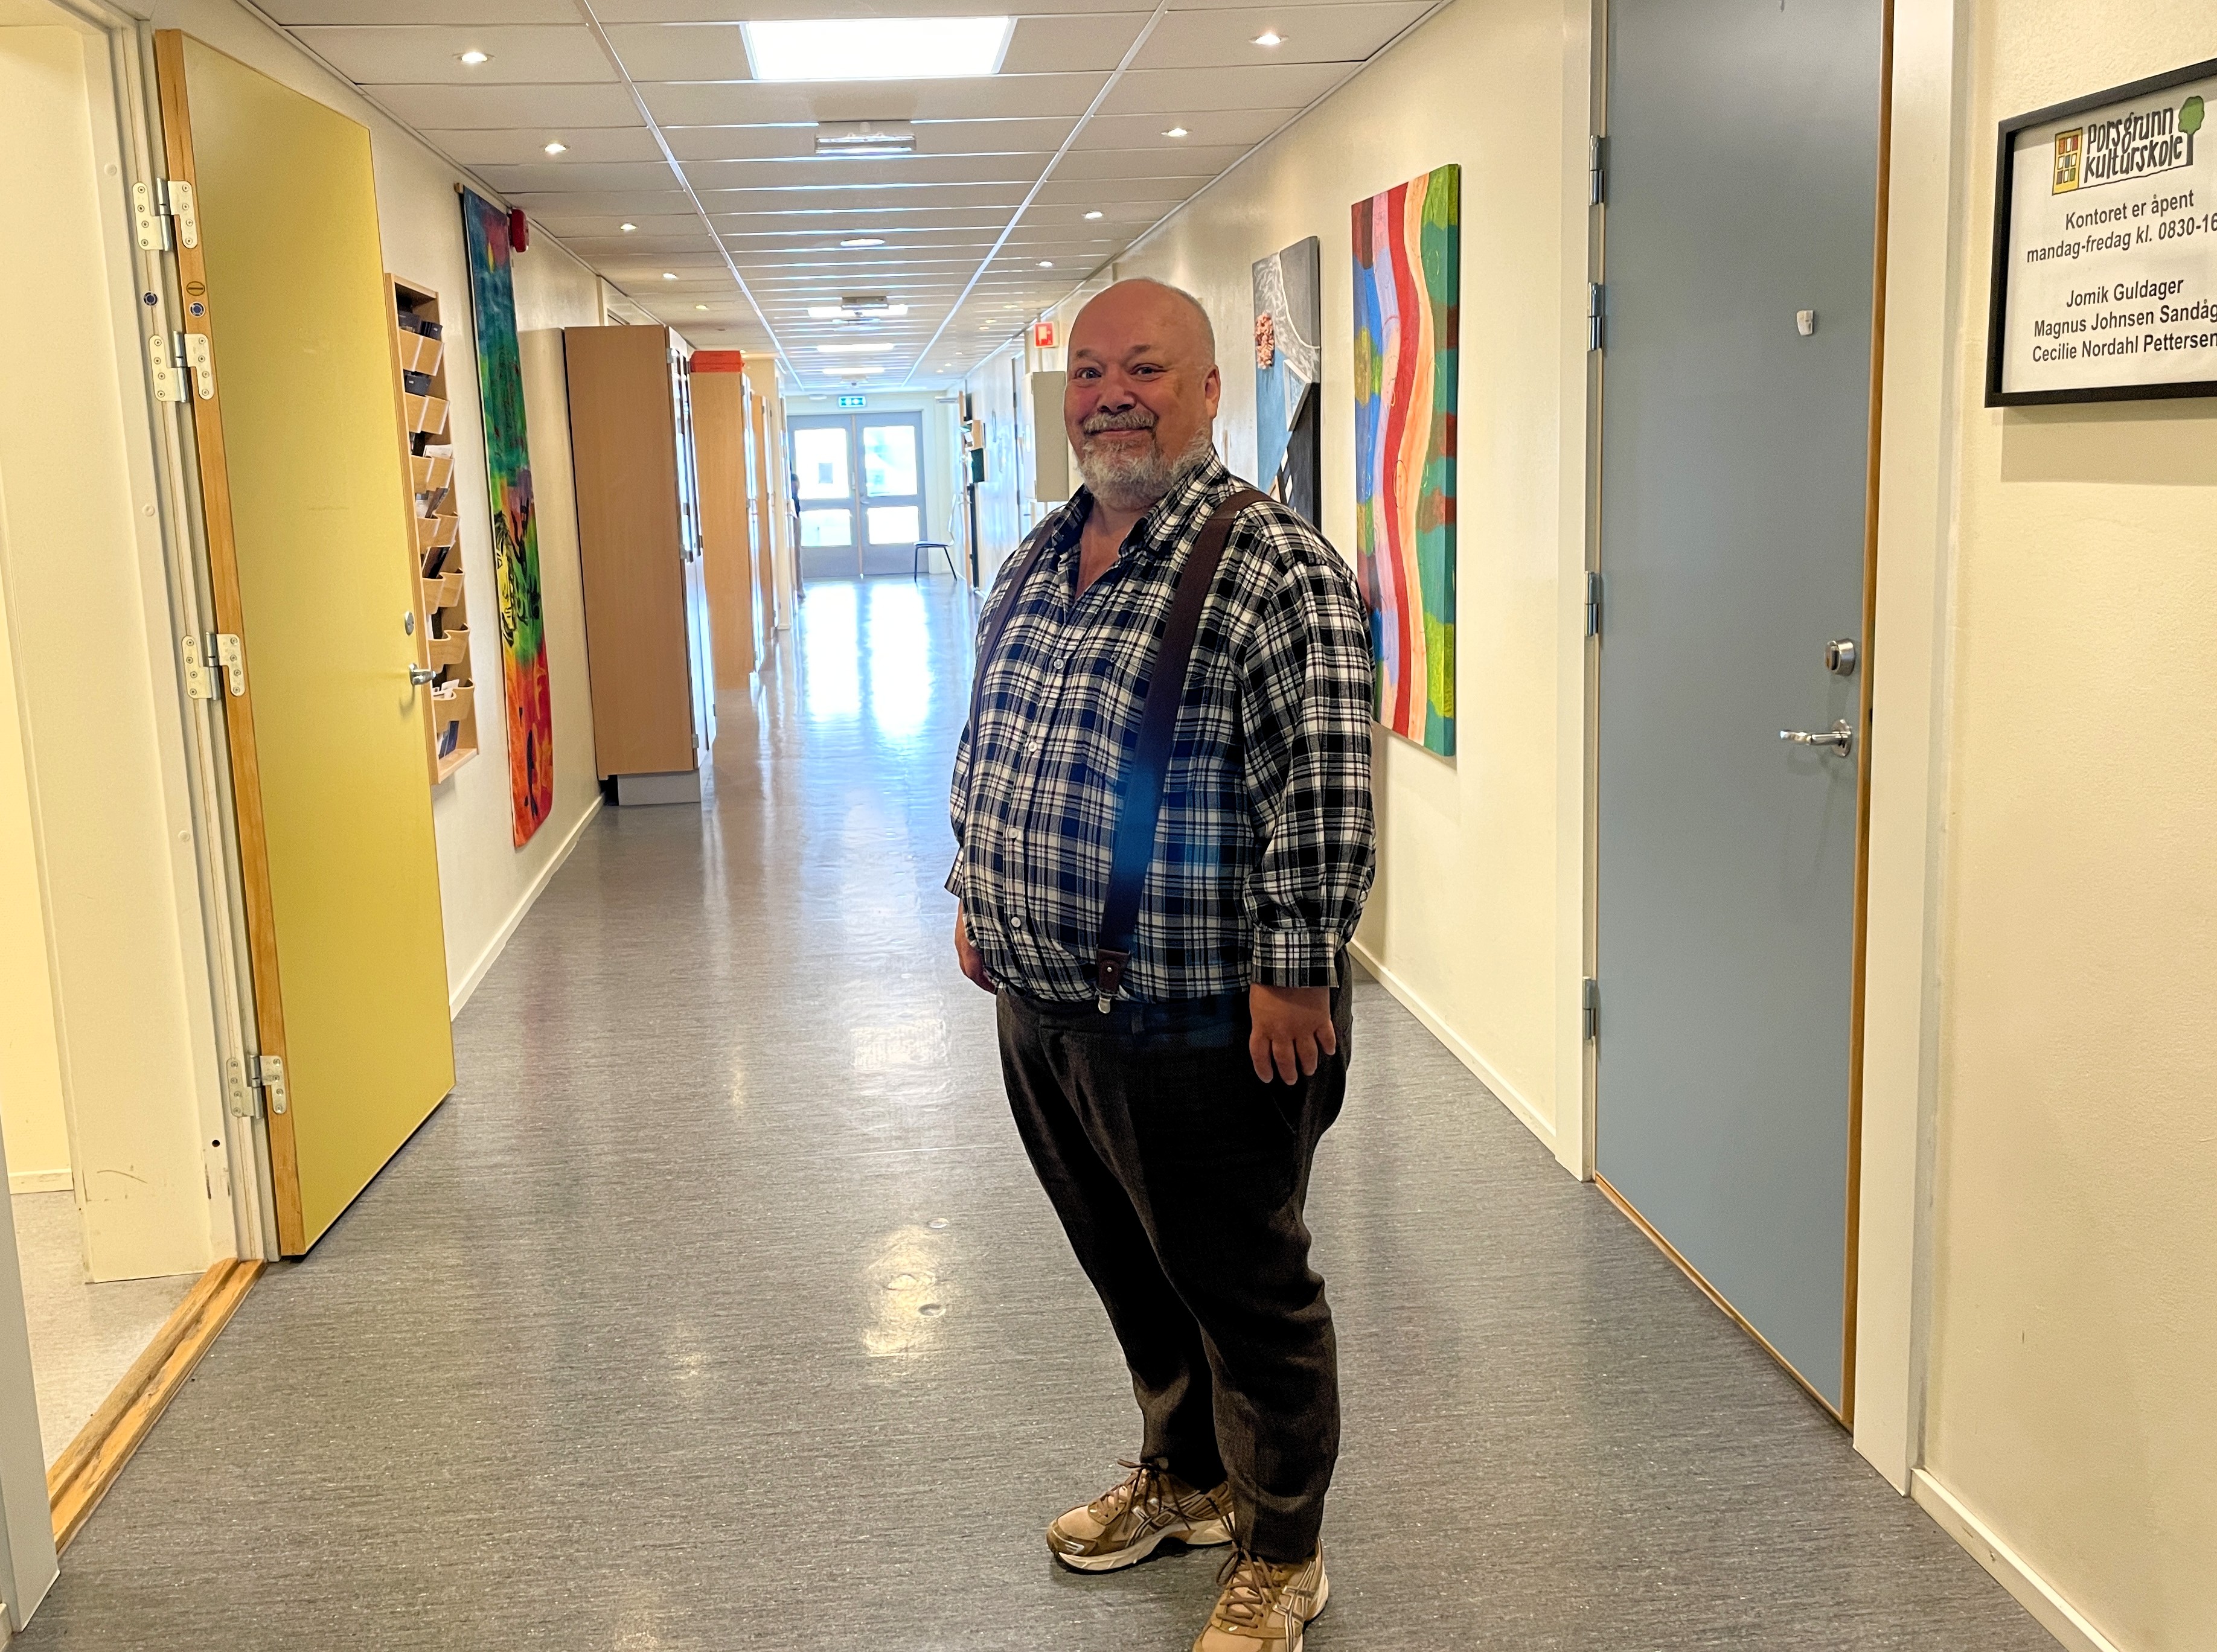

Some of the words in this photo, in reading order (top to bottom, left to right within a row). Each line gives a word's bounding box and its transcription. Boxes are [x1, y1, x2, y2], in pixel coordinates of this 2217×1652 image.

[2066, 203, 2128, 231] Kontoret
[2132, 202, 2147, 218] er
[2151, 190, 2194, 217] åpent
[2027, 231, 2132, 263] mandag-fredag
[2136, 225, 2152, 244] kl.
[2067, 286, 2109, 308] Jomik
[2114, 279, 2184, 301] Guldager
[2034, 319, 2087, 340] Magnus
[2091, 311, 2154, 331] Johnsen
[2160, 299, 2217, 323] Sandåg
[2033, 343, 2077, 362] Cecilie
[2082, 336, 2139, 358] Nordahl
[2144, 333, 2217, 352] Pettersen
